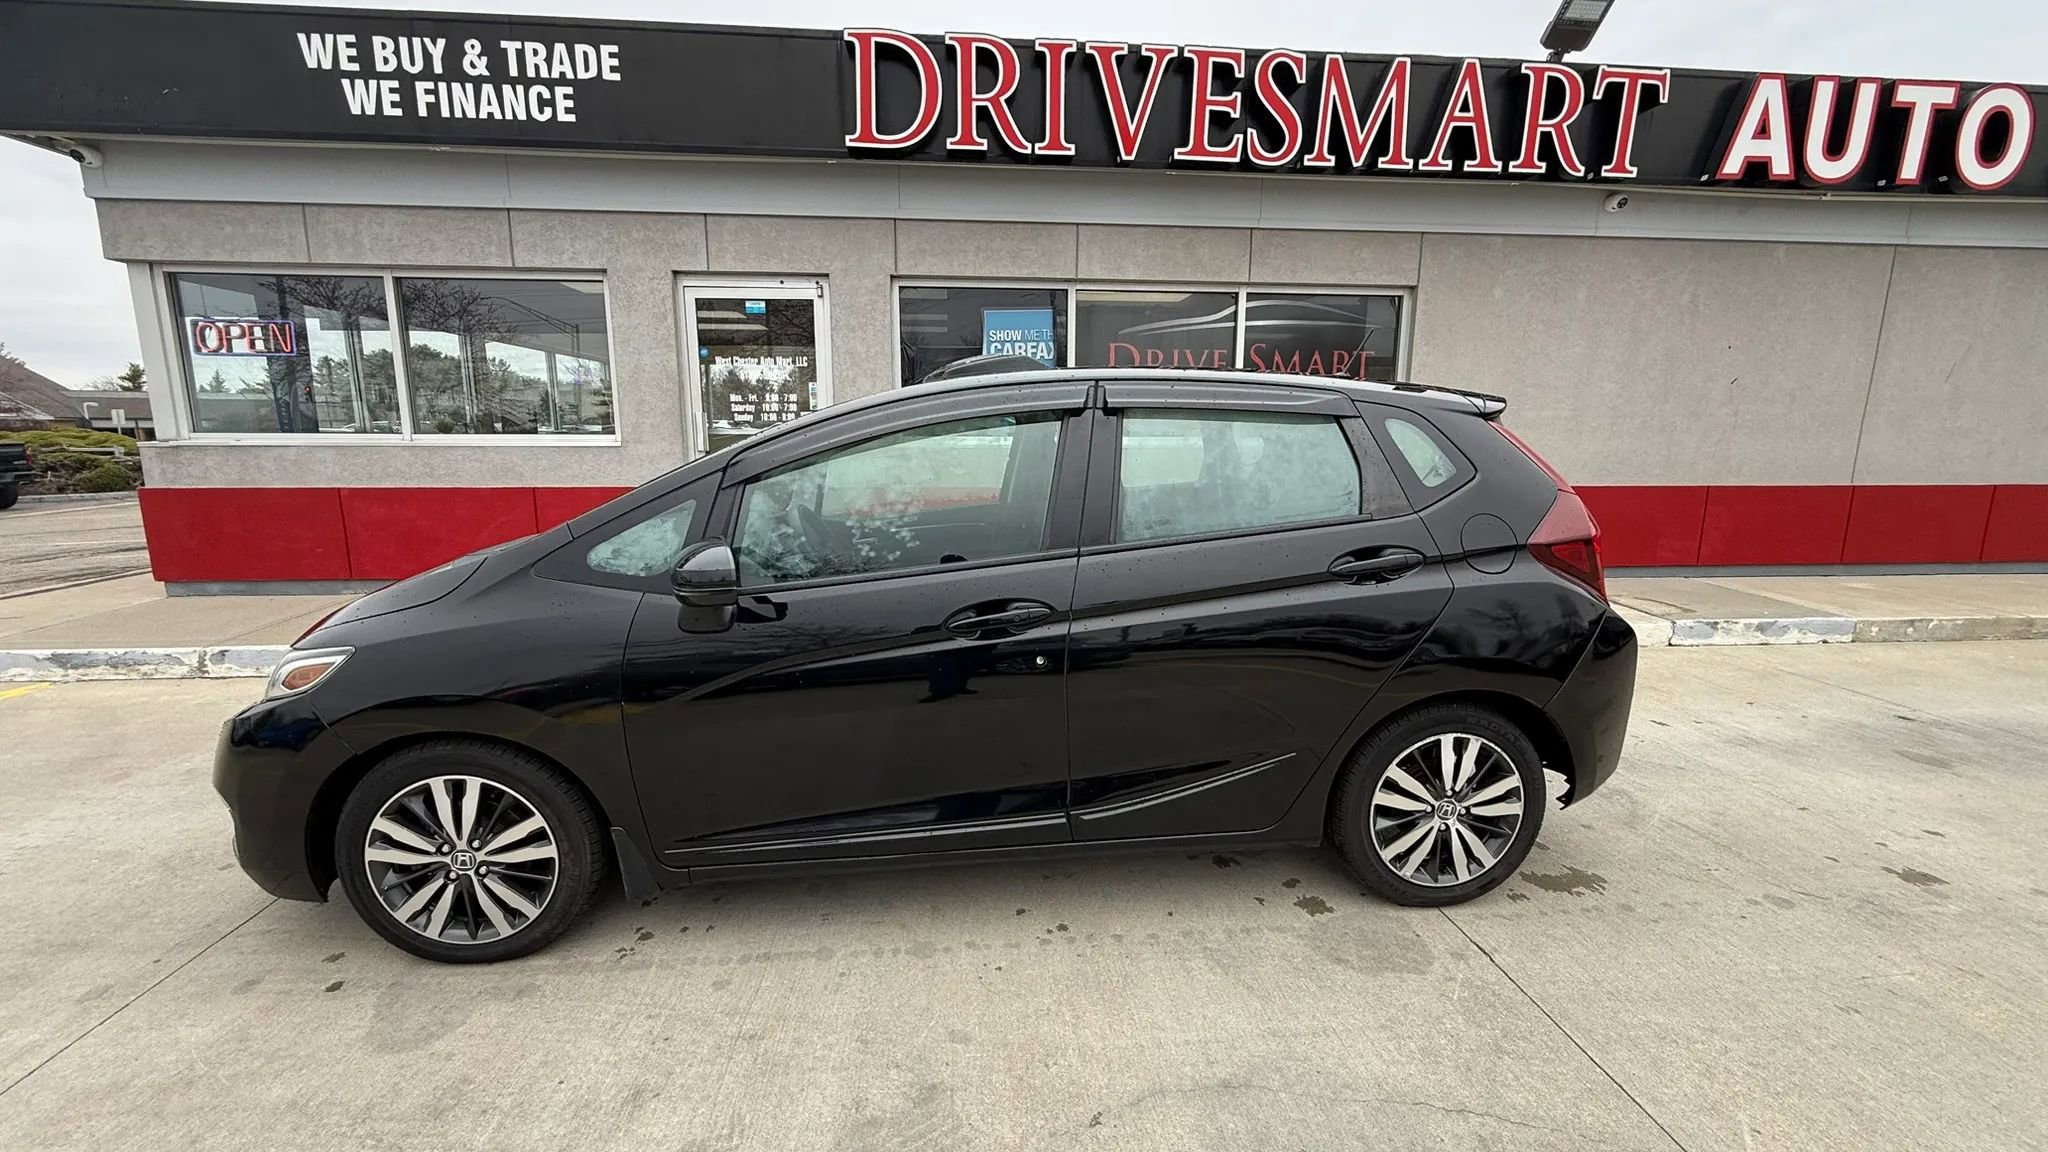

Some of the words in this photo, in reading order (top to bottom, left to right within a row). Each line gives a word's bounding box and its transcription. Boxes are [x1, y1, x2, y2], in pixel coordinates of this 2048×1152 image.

[297, 32, 360, 71] WE
[372, 35, 446, 74] BUY
[462, 38, 490, 76] &
[500, 40, 621, 81] TRADE
[341, 78, 403, 116] WE
[415, 81, 576, 122] FINANCE
[842, 28, 1671, 179] DRIVESMART
[1715, 72, 2036, 191] AUTO
[195, 321, 291, 352] OPEN
[989, 329, 1022, 341] SHOW
[1025, 329, 1040, 341] ME
[760, 356, 774, 366] Auto
[796, 356, 808, 367] LLC
[784, 393, 797, 402] 7:00
[731, 403, 755, 413] Saturday
[734, 413, 753, 422] Sunday
[760, 412, 777, 421] 10:00
